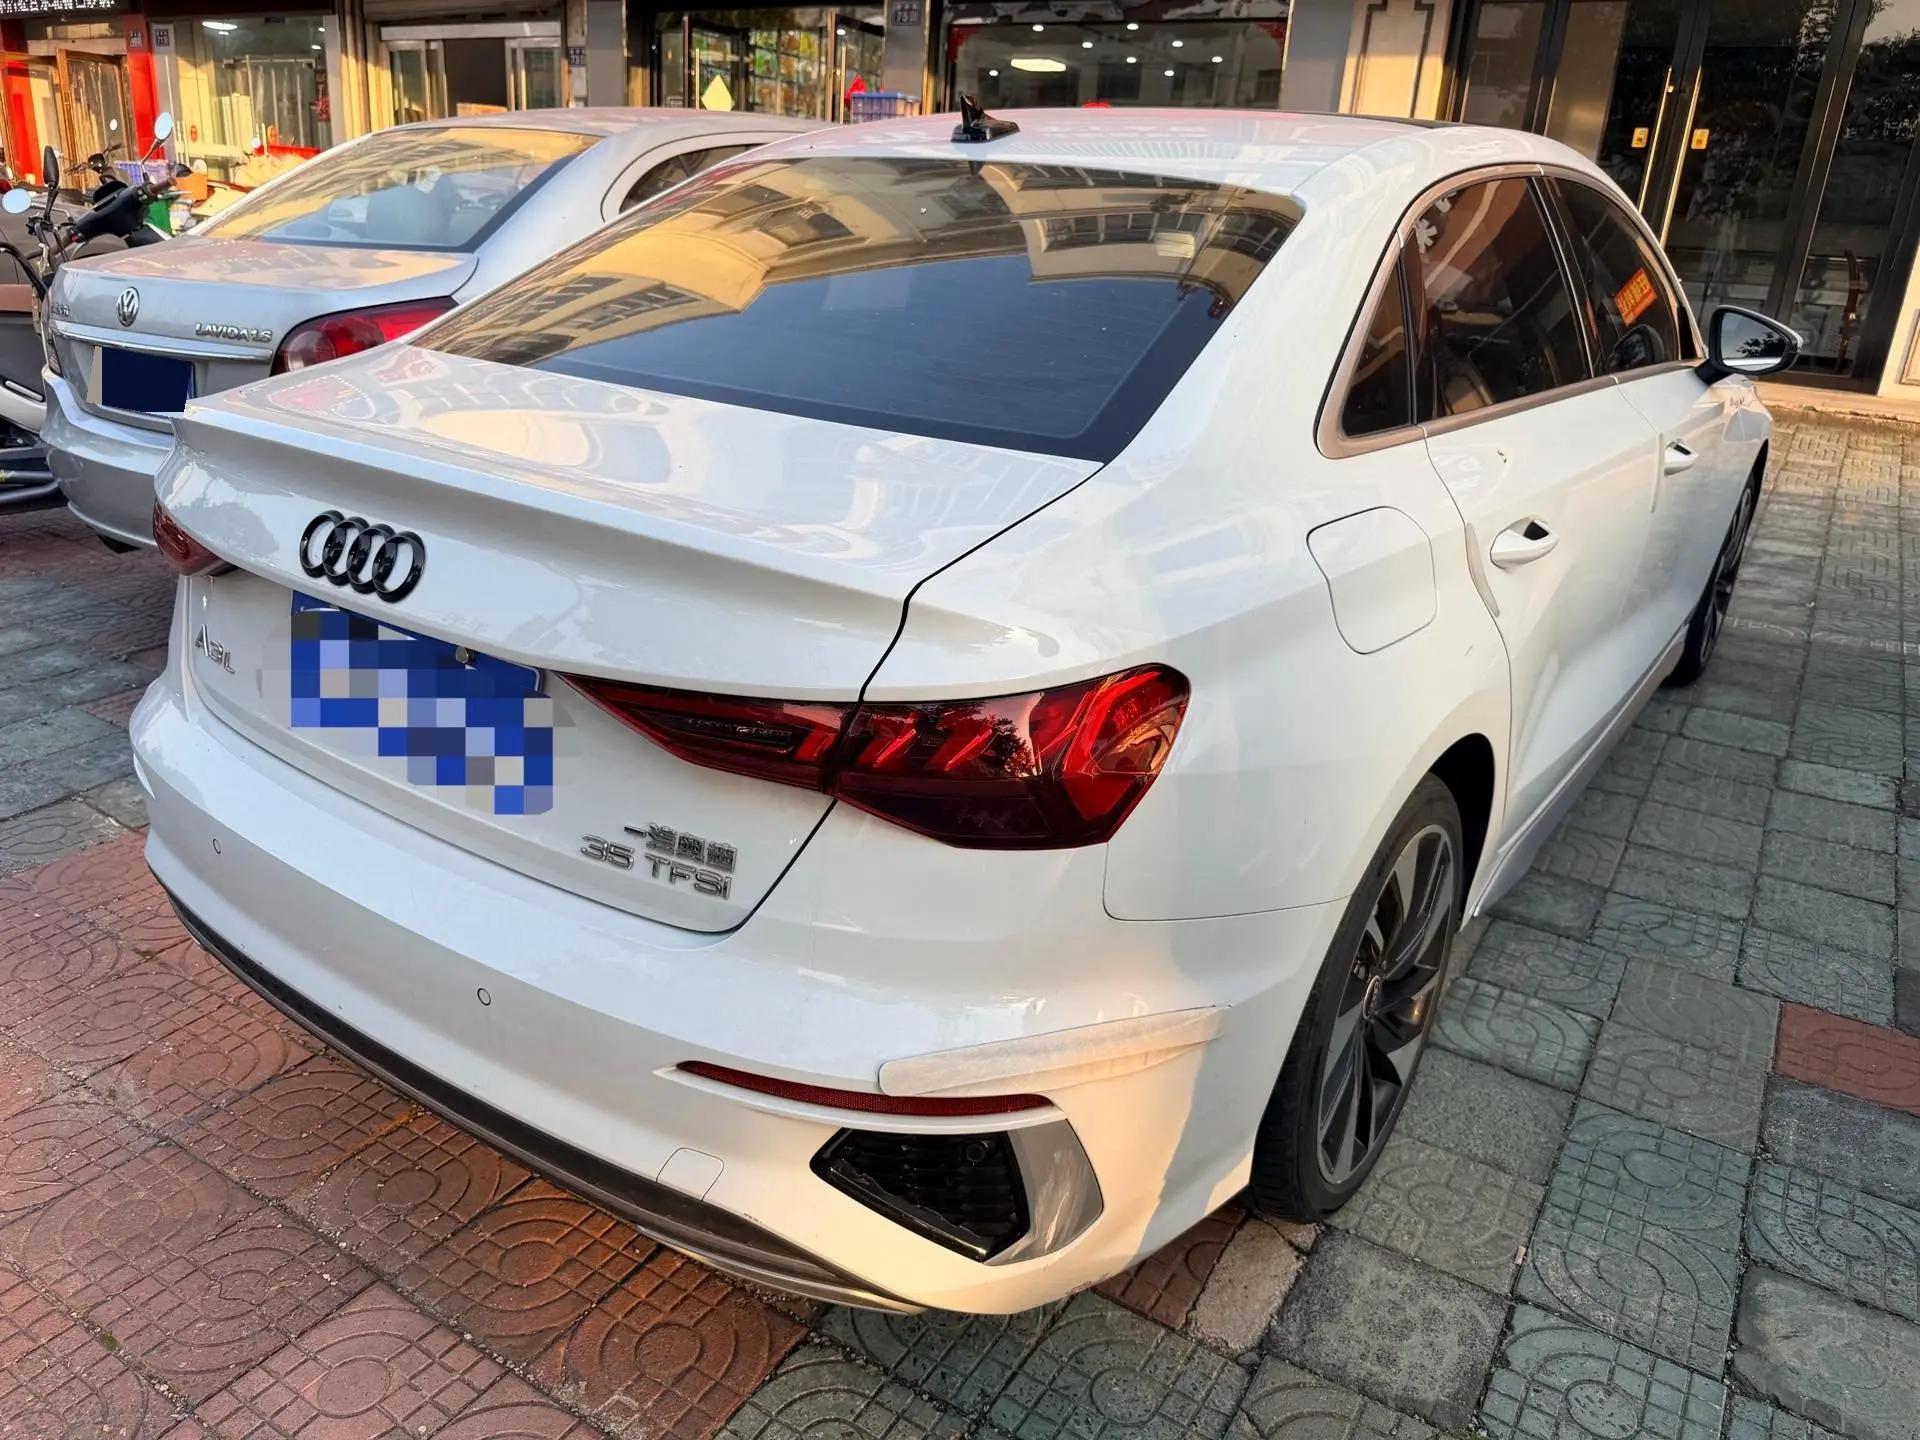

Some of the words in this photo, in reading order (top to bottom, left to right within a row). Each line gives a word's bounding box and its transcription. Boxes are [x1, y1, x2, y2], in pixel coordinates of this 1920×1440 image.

[195, 623, 235, 674] A3L
[581, 833, 635, 871] 35
[645, 852, 733, 901] TFSI
